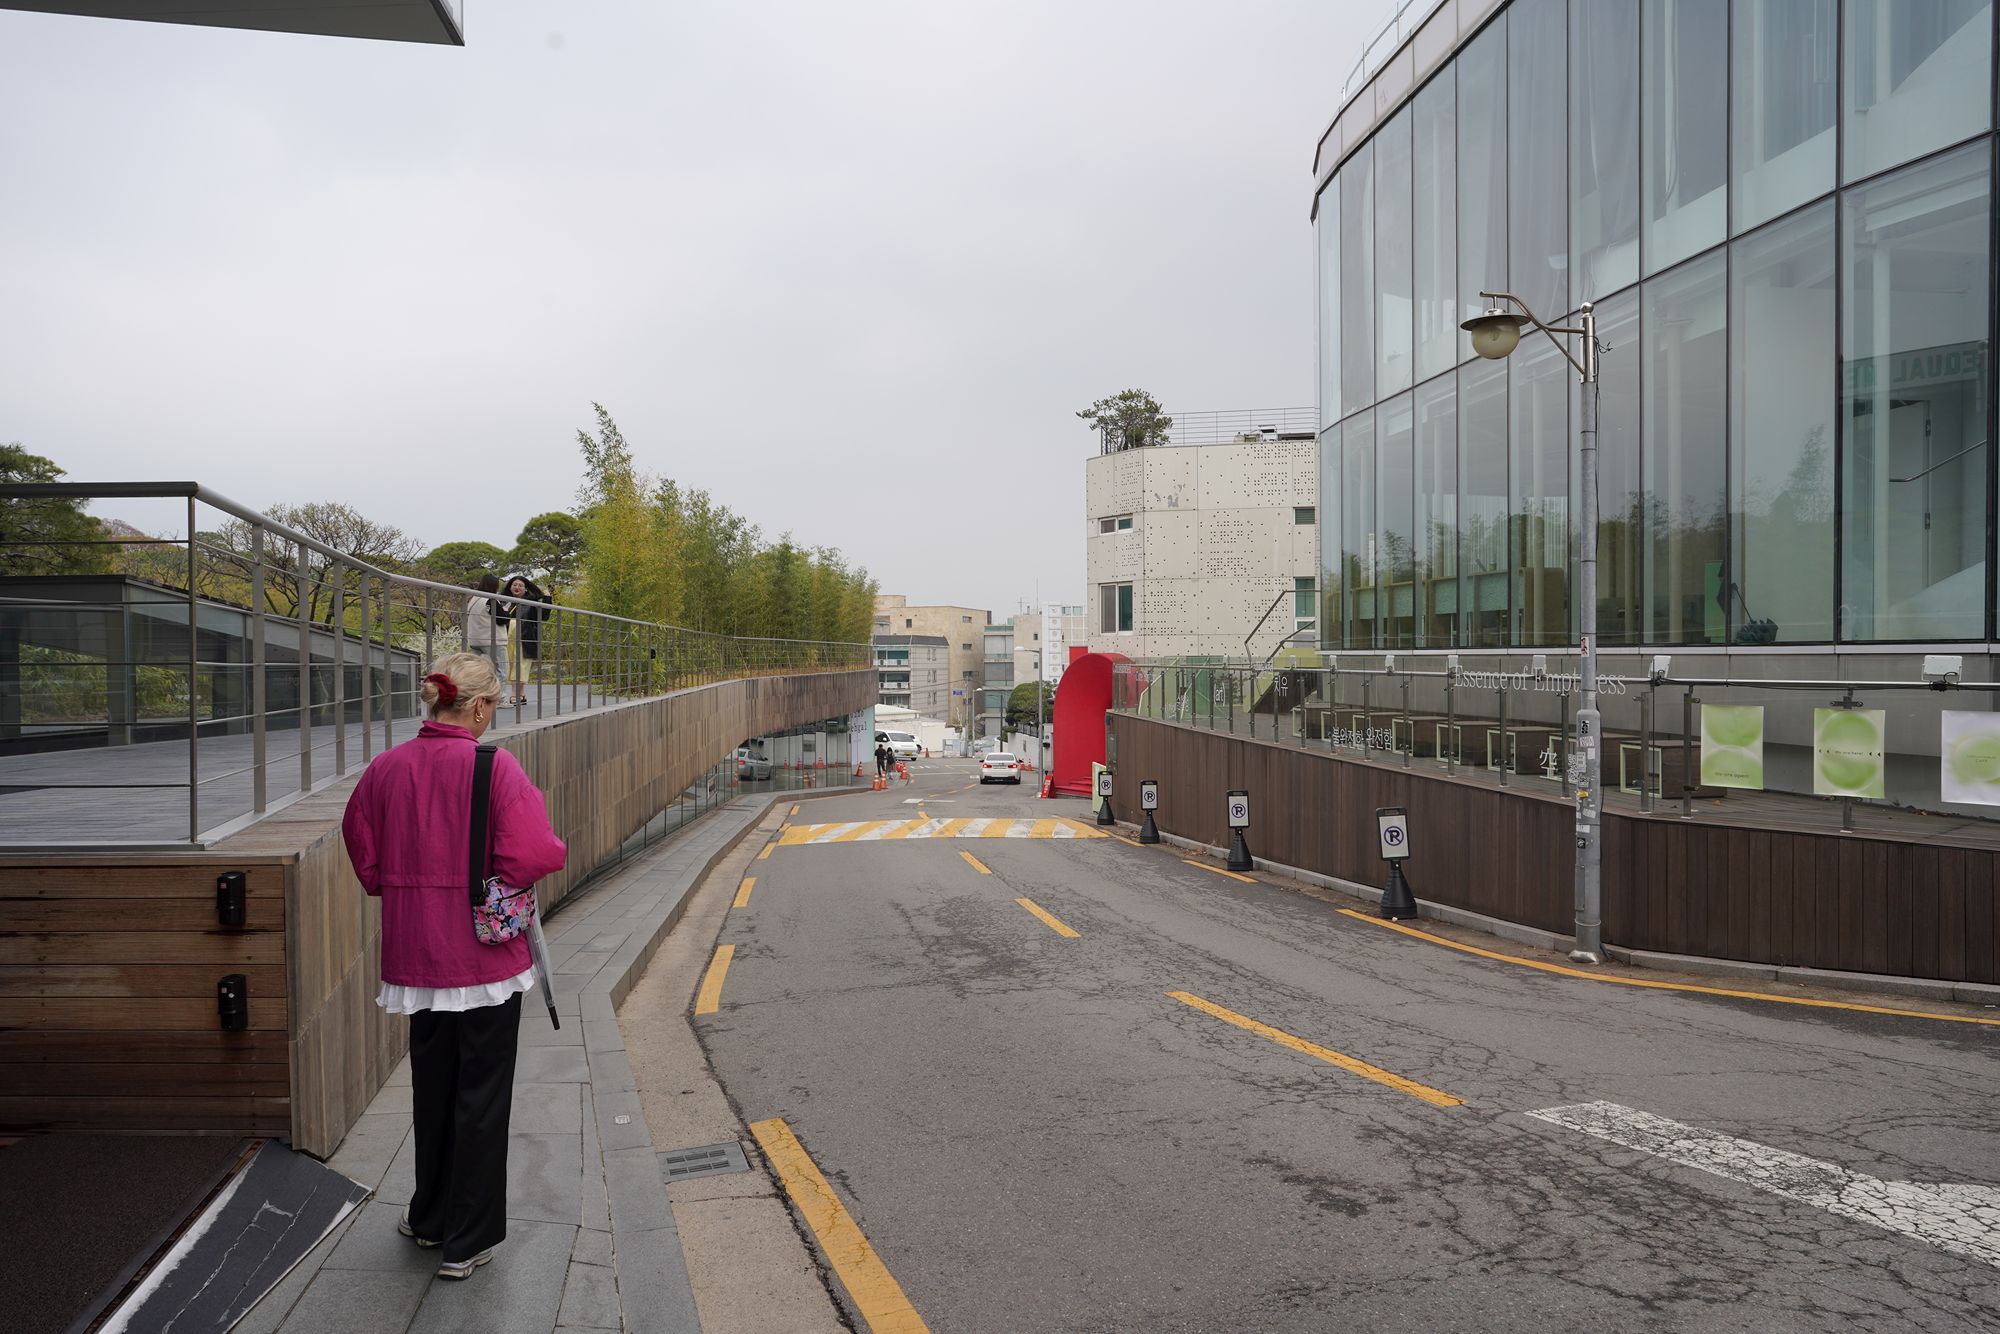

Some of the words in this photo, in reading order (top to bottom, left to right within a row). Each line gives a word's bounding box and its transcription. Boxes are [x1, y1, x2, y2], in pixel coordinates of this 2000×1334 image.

[1273, 675, 1289, 697] 치유
[1455, 665, 1508, 689] Essence
[1513, 665, 1529, 691] of
[1534, 666, 1627, 696] Emptess
[1332, 726, 1365, 750] 불완전한
[1366, 726, 1393, 750] 완전함
[1539, 747, 1559, 779] 空
